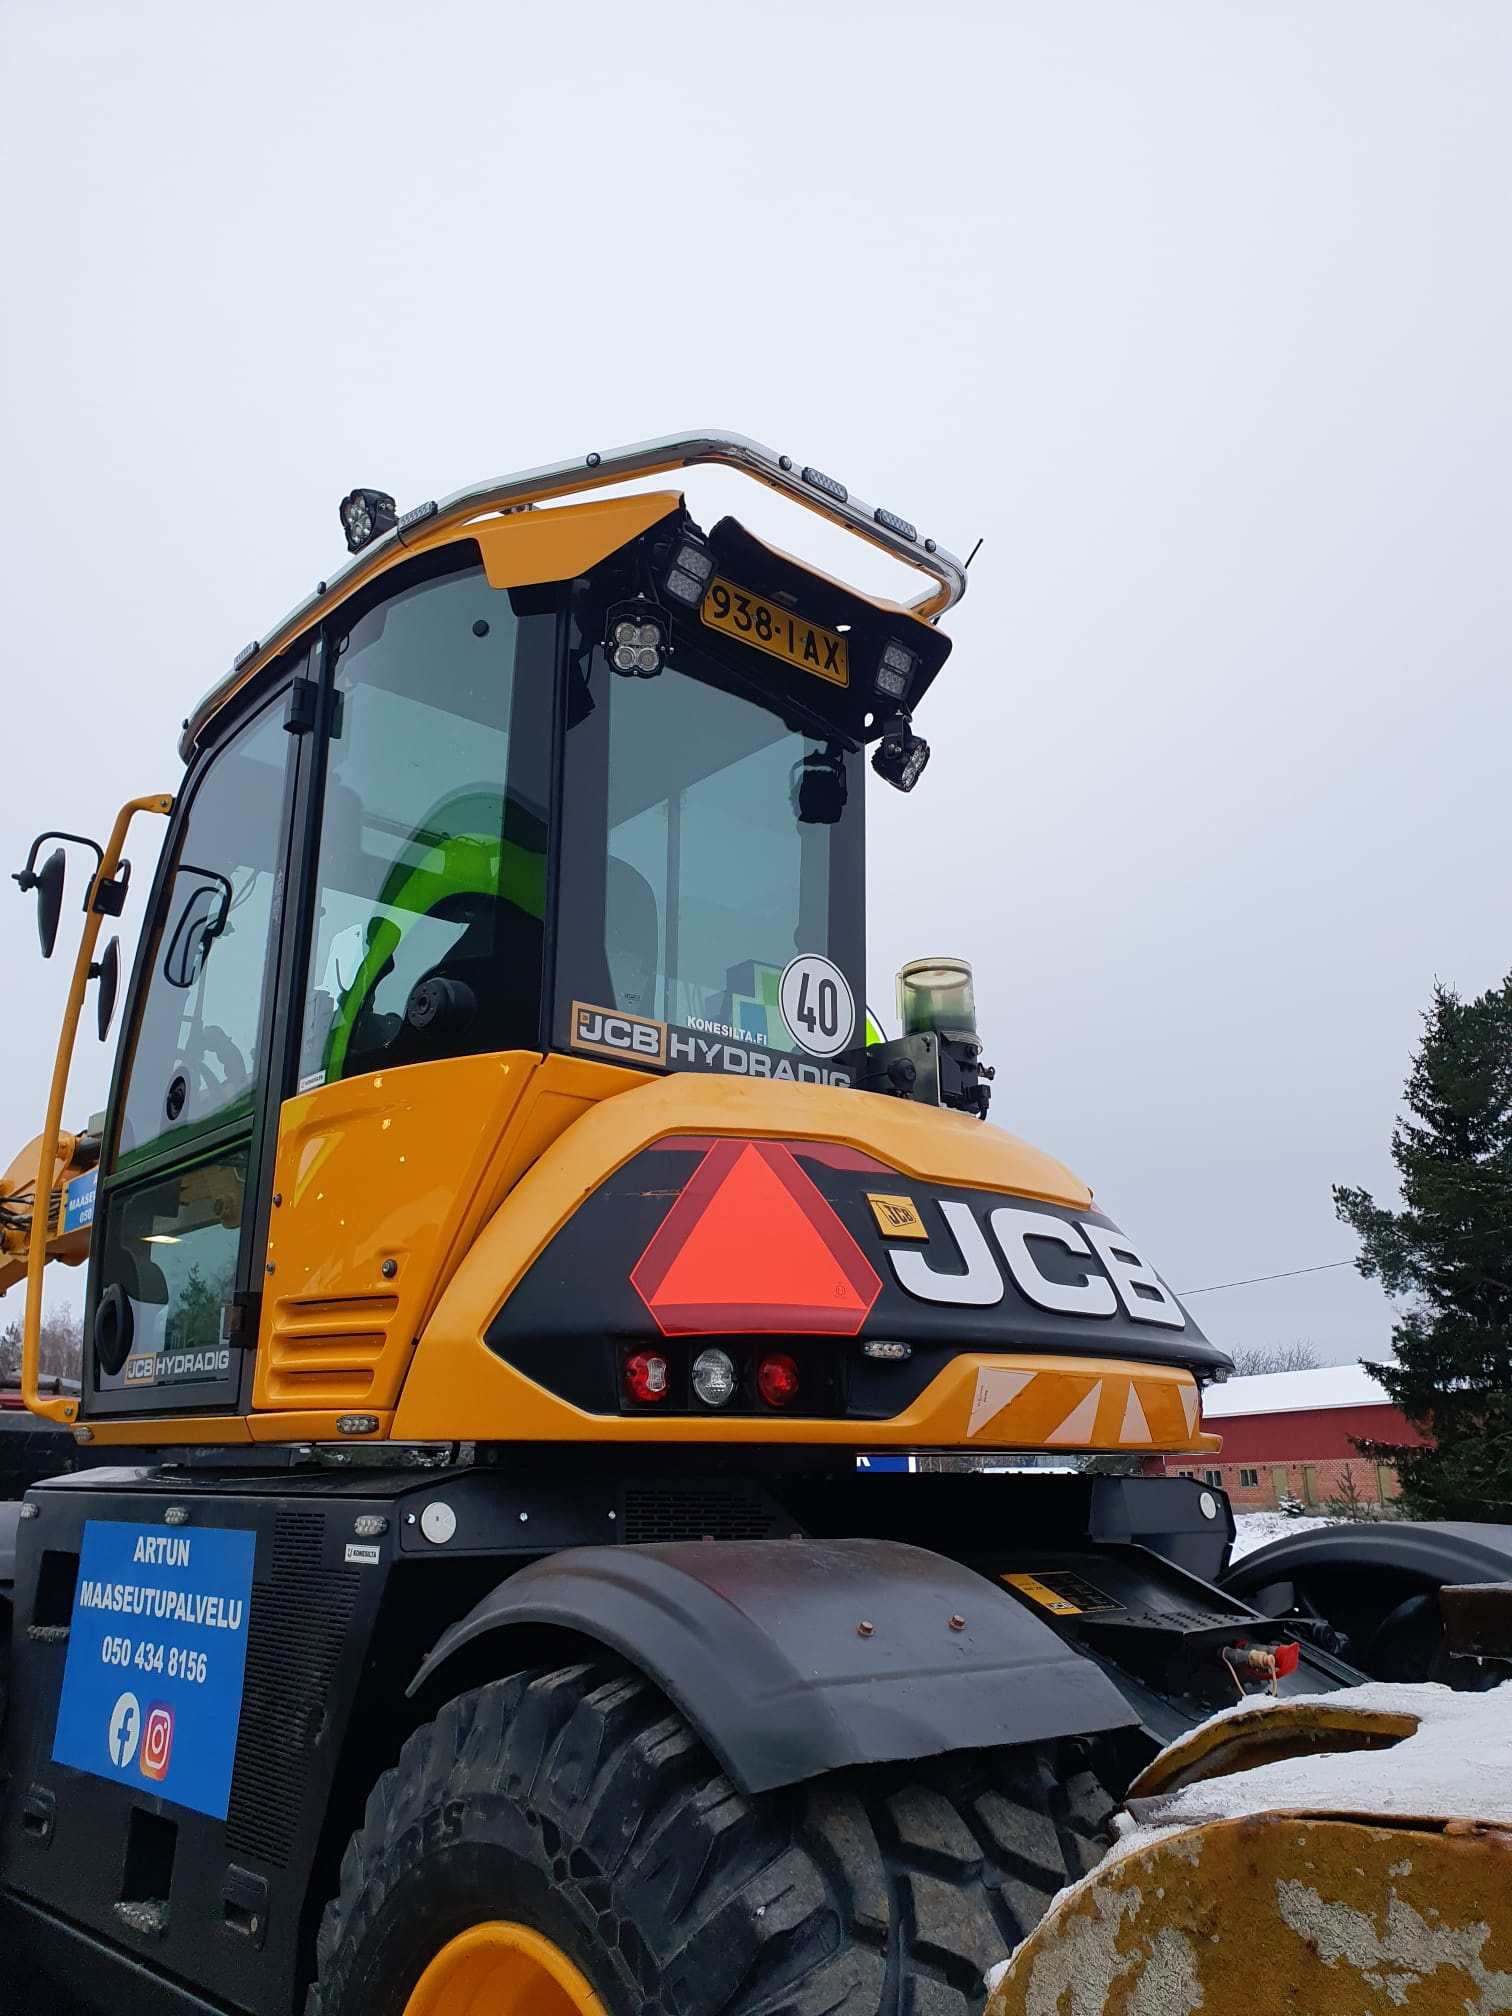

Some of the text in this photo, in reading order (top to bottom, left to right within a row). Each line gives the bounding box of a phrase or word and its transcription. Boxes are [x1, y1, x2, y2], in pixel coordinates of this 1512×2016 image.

[711, 585, 840, 675] 938-IAX
[797, 972, 838, 1037] 40
[579, 1012, 659, 1054] JCB
[687, 1015, 767, 1045] KONESILTA.FI
[883, 1204, 914, 1225] JCB
[888, 1200, 1186, 1327] JCB
[127, 1350, 230, 1379] JCB HYDRADIG
[133, 1535, 191, 1567] ARTUN
[79, 1580, 243, 1630] MAASEUTUPALVELU
[102, 1635, 208, 1684] 050 434 8156
